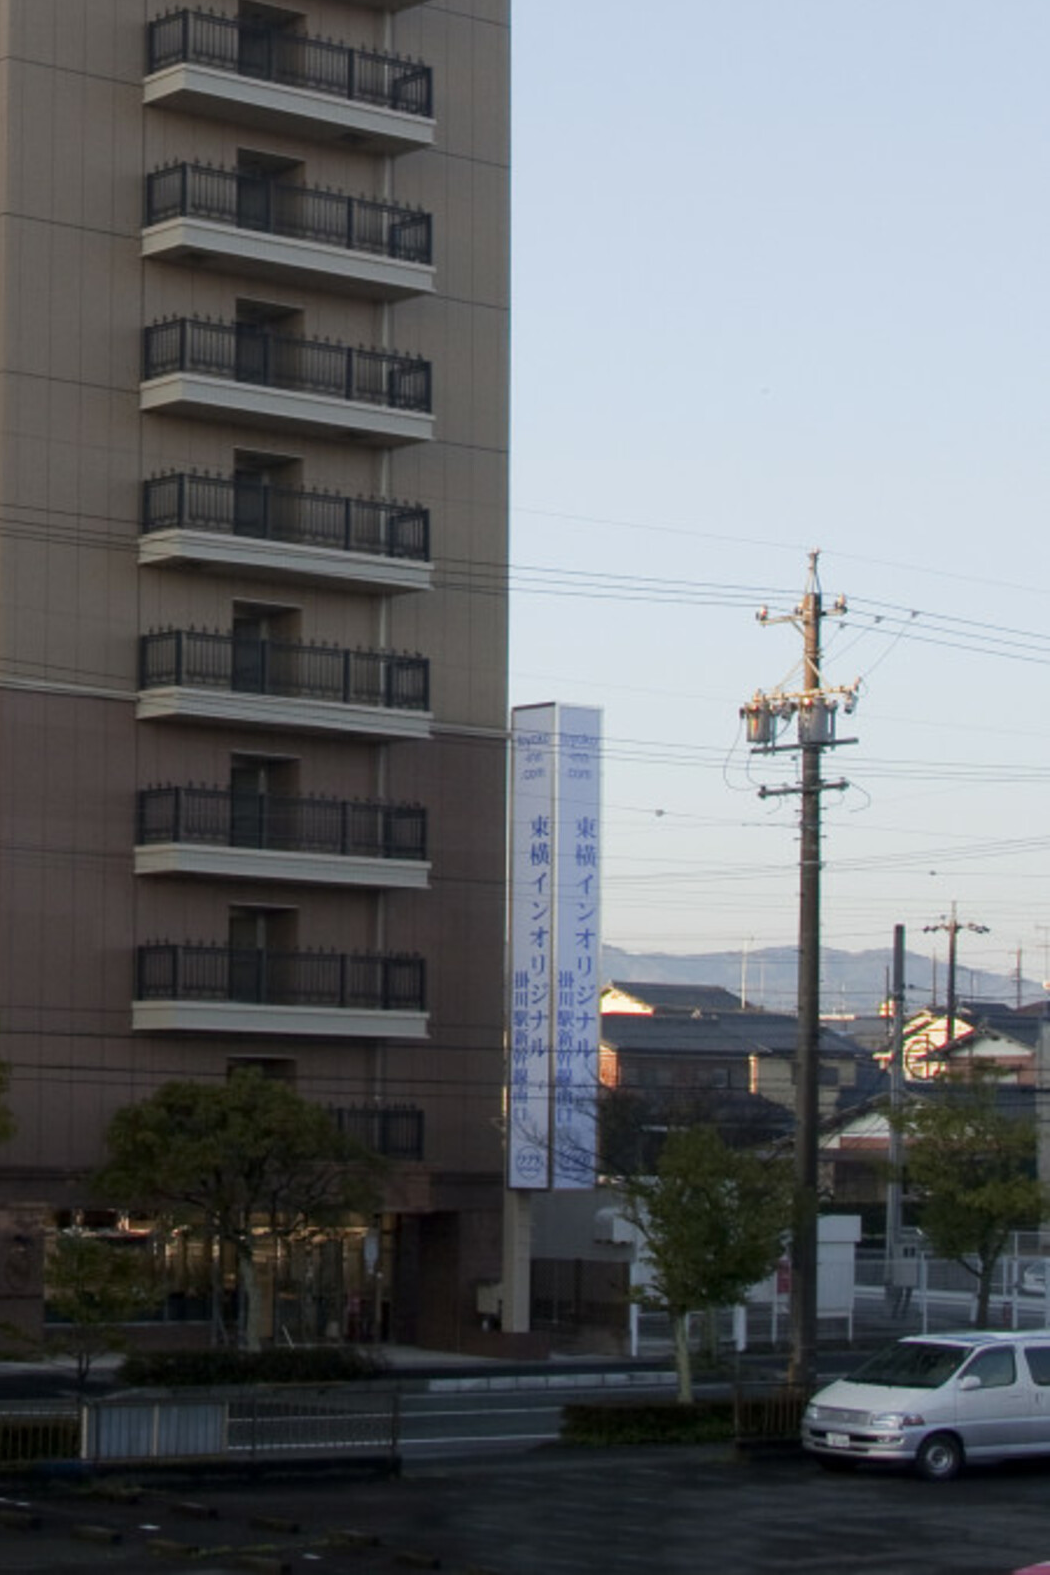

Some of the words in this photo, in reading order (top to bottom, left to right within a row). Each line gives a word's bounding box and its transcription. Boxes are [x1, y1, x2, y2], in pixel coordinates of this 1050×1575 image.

[530, 815, 549, 1057] 東横インオリジナル
[575, 817, 596, 1059] 東横インオリジナル
